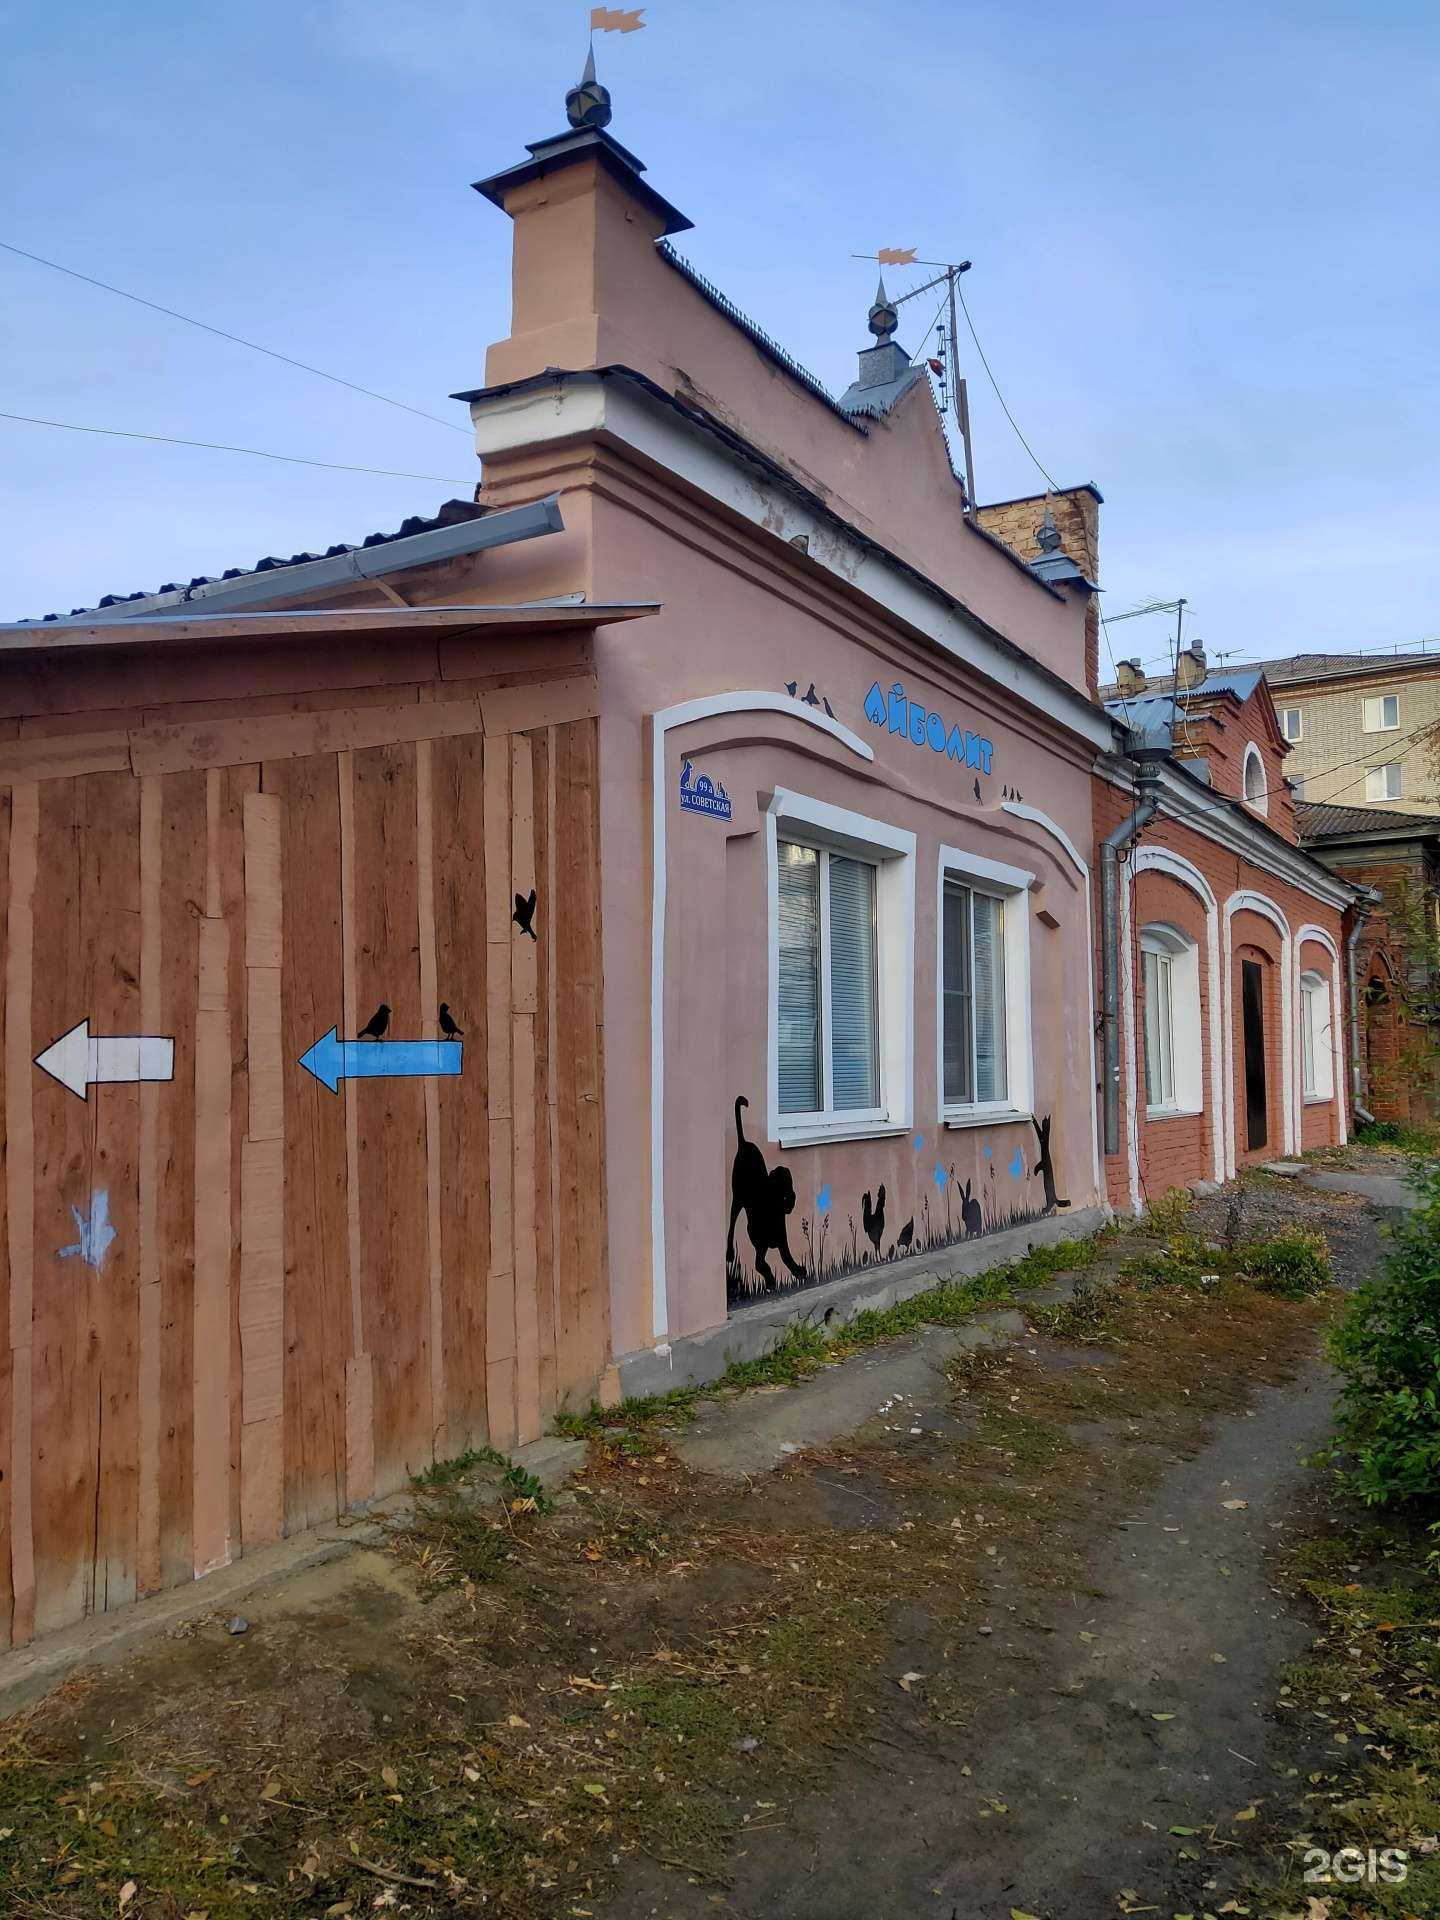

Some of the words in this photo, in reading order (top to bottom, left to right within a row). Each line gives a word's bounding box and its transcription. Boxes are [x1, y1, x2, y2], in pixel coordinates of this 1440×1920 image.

[864, 681, 993, 775] АЙБОЛИТ
[700, 781, 708, 792] 99
[691, 795, 730, 813] СОВЕТСКАЯ
